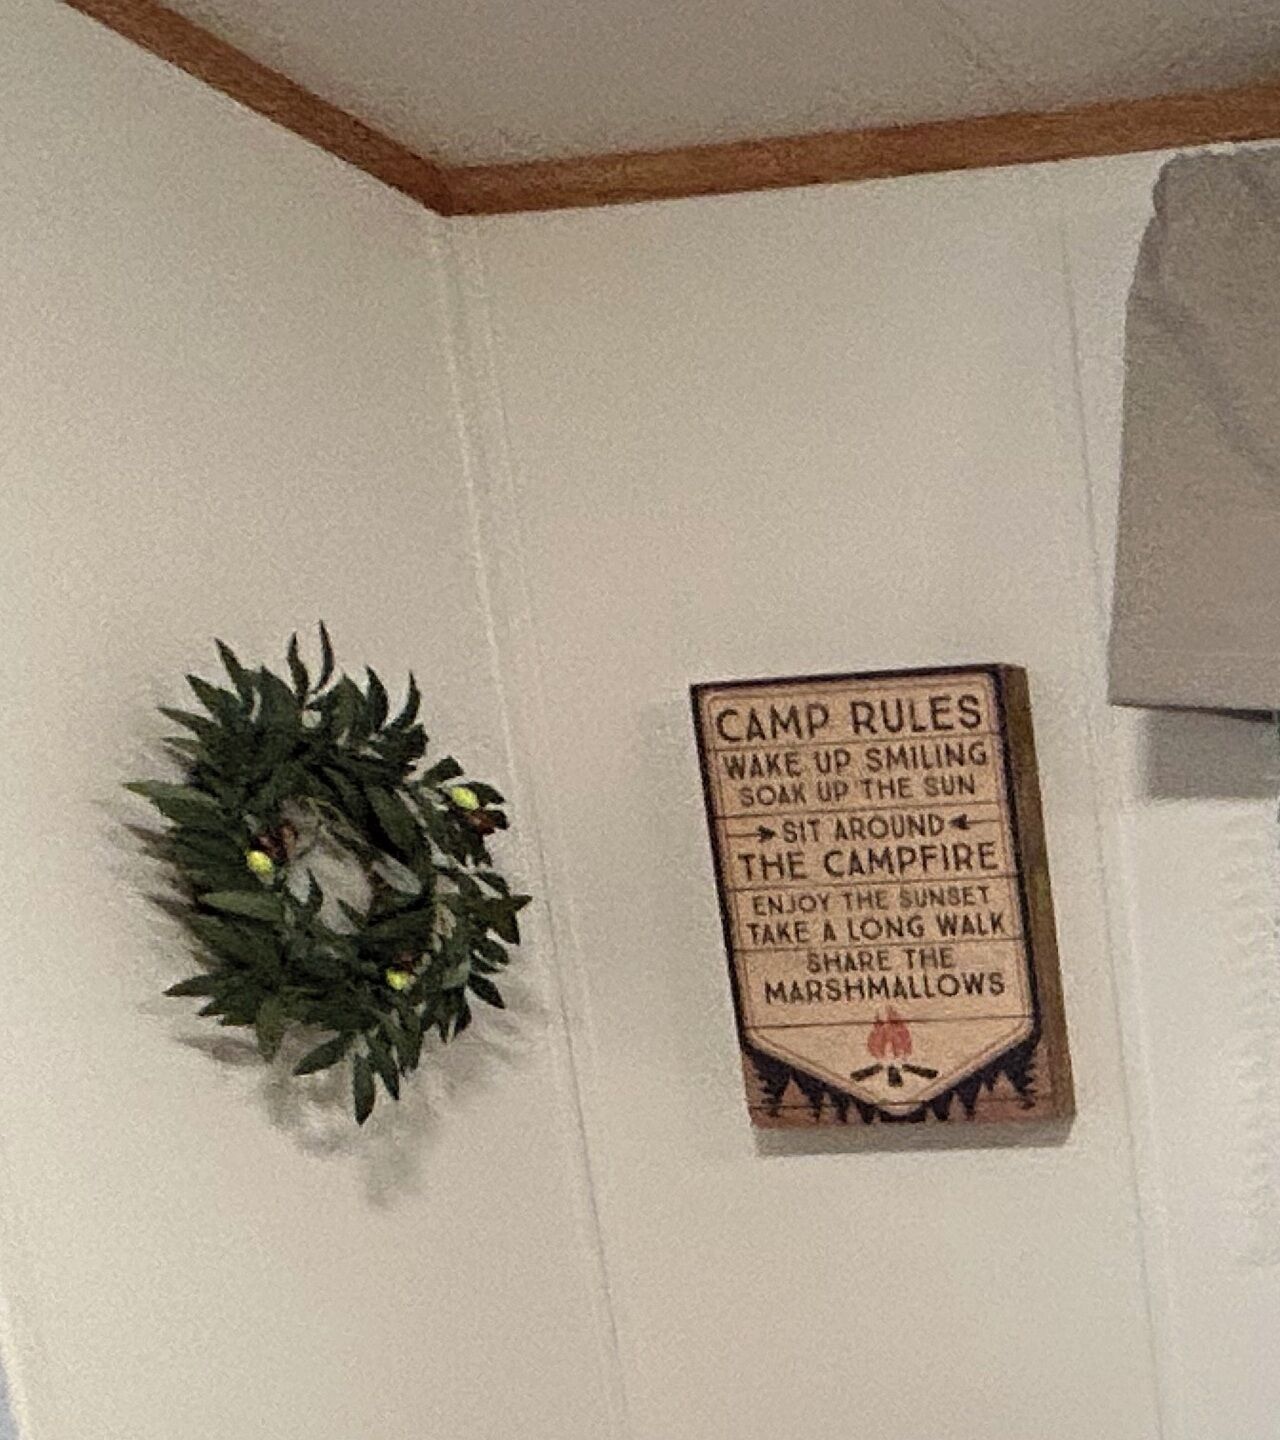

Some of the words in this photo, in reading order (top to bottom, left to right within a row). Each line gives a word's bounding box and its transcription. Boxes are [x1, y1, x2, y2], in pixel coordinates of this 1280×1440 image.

[716, 700, 829, 742] CAMP
[851, 694, 981, 736] RULES
[723, 749, 800, 779] WAKE
[816, 748, 850, 774] UP
[866, 741, 987, 771] SMILING
[738, 779, 805, 807] SOAK
[818, 777, 849, 801] UP
[861, 776, 913, 800] THE
[924, 773, 975, 797] SUN
[782, 819, 819, 843] SIT
[835, 813, 944, 841] AROUND
[738, 852, 804, 880] THE
[824, 842, 998, 878] CAMPFIRE
[753, 891, 829, 917] ENJOY
[843, 889, 888, 911] THE
[900, 885, 989, 908] SUNSET
[747, 920, 805, 947] TAKE
[822, 920, 835, 941] A
[848, 915, 925, 941] LONG
[937, 910, 1004, 936] WALK
[806, 947, 891, 974] SHARE
[906, 945, 954, 970] THE
[764, 972, 1005, 1006] MARSHMALLOWS
